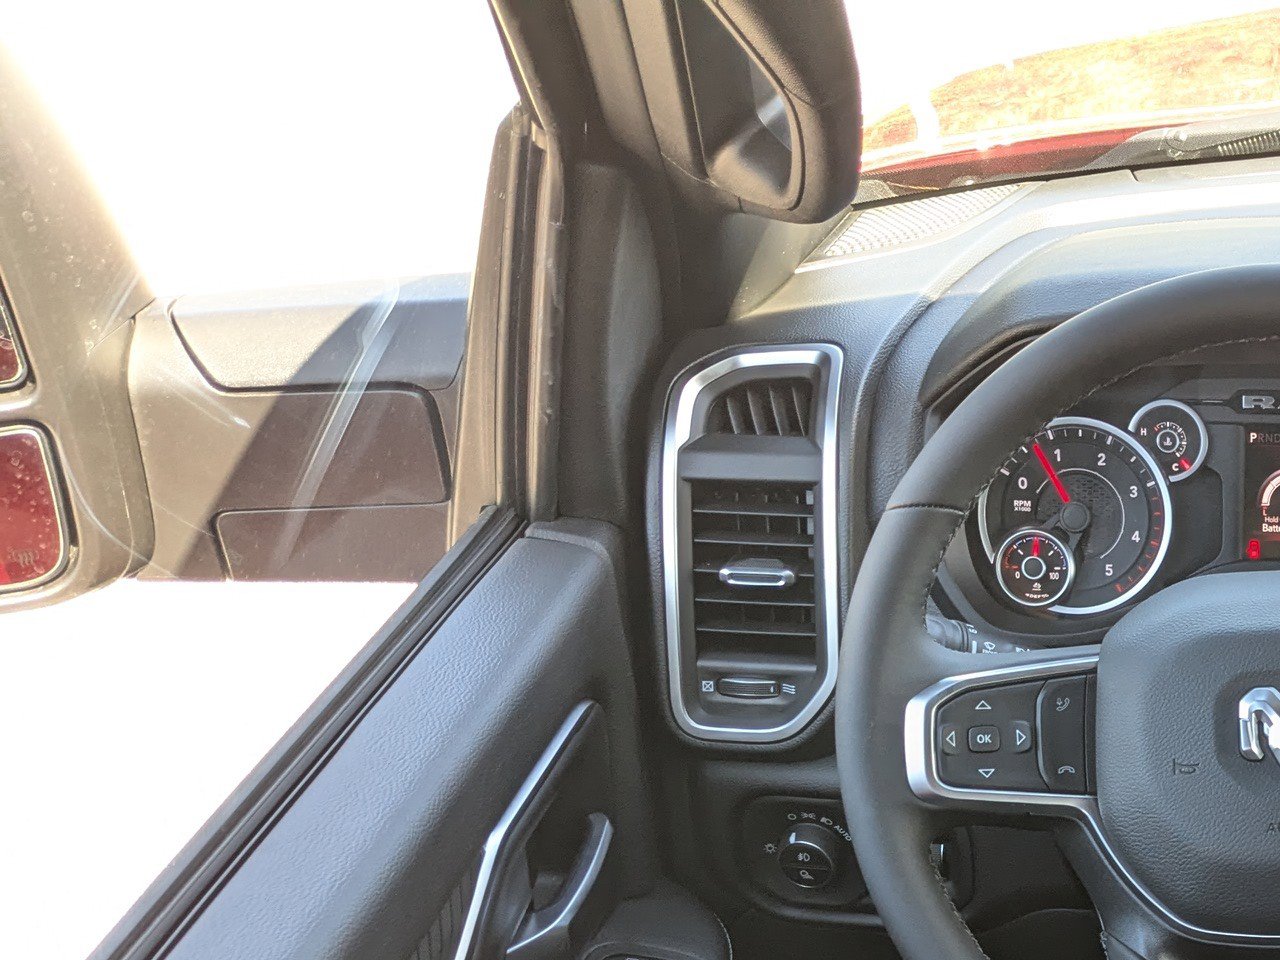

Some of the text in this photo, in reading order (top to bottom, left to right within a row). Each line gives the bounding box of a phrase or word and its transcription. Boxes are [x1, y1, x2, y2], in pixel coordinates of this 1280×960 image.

[1140, 428, 1147, 436] H
[1053, 449, 1061, 462] 1
[1097, 453, 1106, 466] 2
[1172, 463, 1179, 471] C
[1018, 477, 1028, 490] 0
[1129, 486, 1138, 498] 3
[1132, 530, 1140, 542] 4
[1049, 572, 1060, 580] 100
[1105, 564, 1114, 576] 5
[976, 734, 992, 744] OK
[834, 825, 852, 842] AUTO
